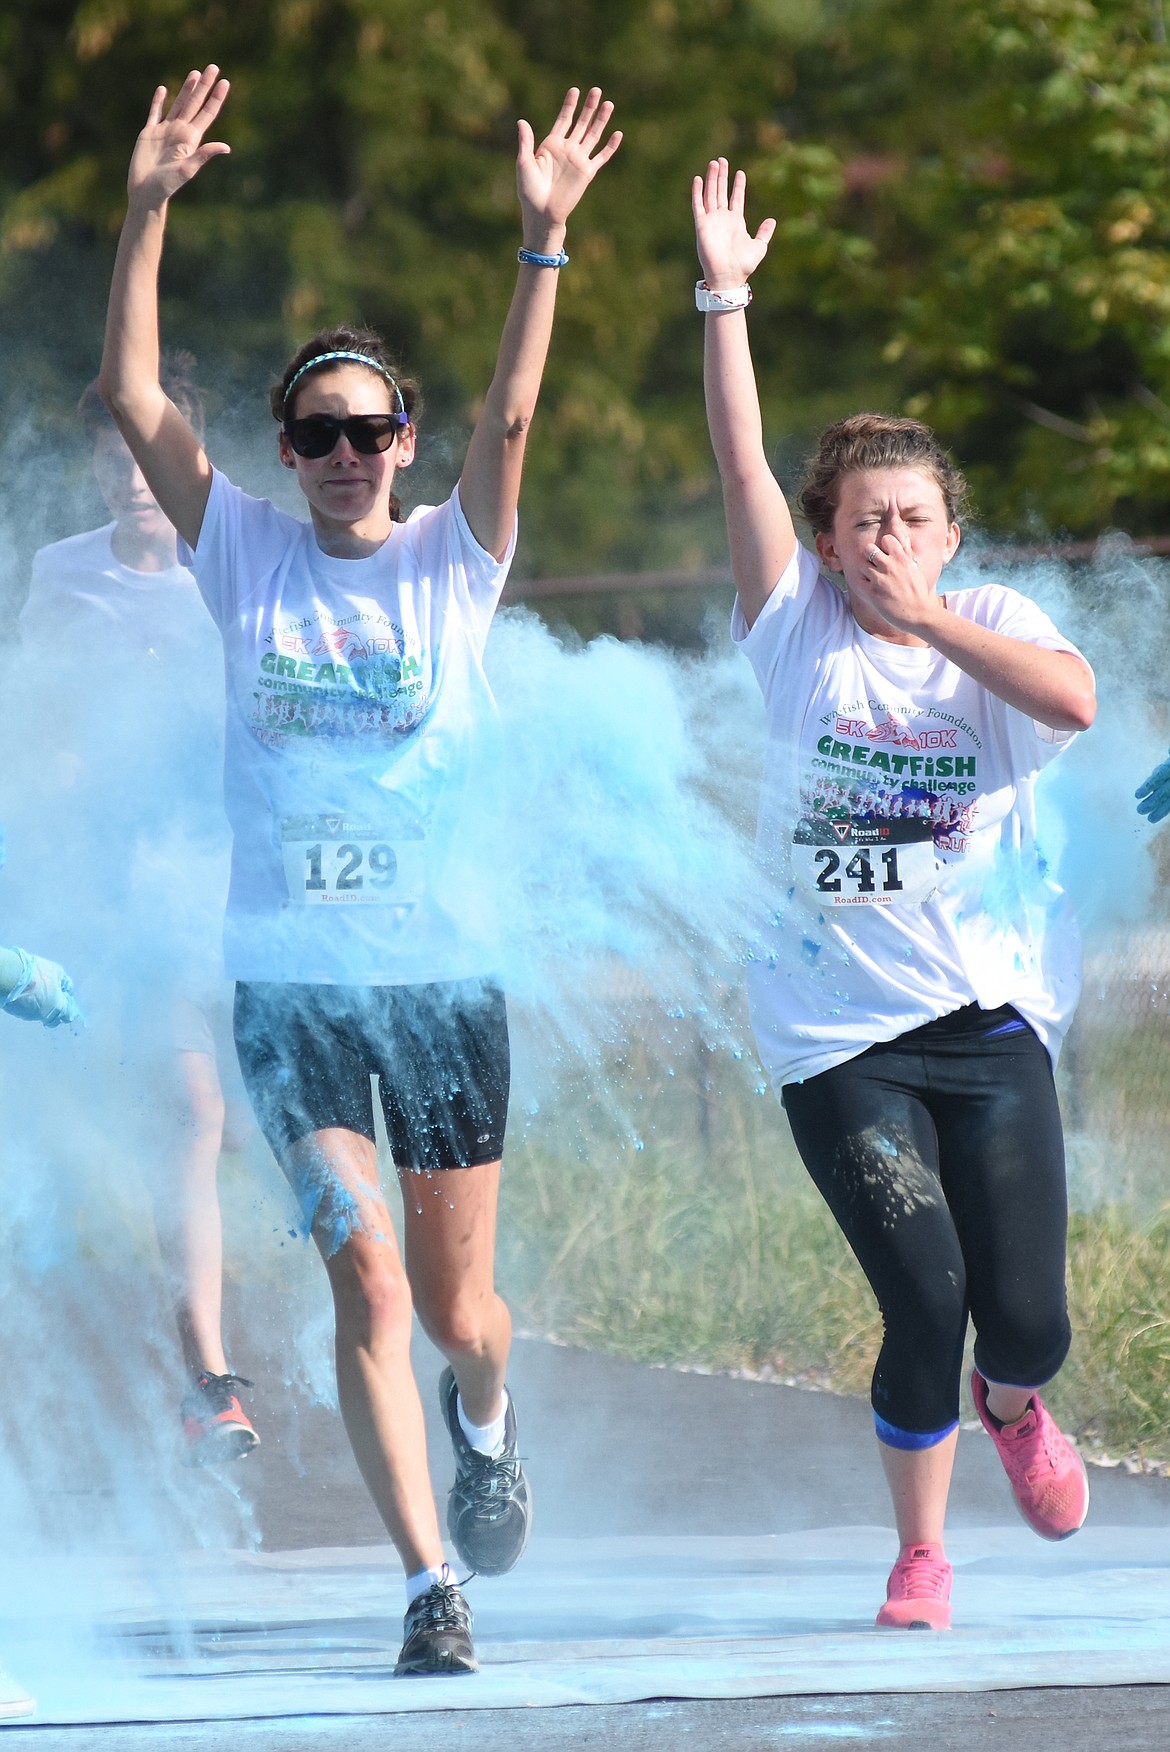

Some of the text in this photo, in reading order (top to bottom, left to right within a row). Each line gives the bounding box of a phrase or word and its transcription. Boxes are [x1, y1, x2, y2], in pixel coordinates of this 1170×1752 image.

[312, 609, 373, 626] Community
[281, 635, 312, 654] 5K
[366, 637, 405, 655] 10K
[258, 675, 347, 699] community
[835, 717, 867, 738] 5K
[928, 707, 983, 750] Foundation
[919, 729, 958, 749] 10K
[811, 757, 976, 796] community challenge
[305, 843, 397, 890] 129
[814, 847, 904, 892] 241
[834, 896, 892, 904] RoadID.com
[912, 1549, 931, 1558] NIKE
